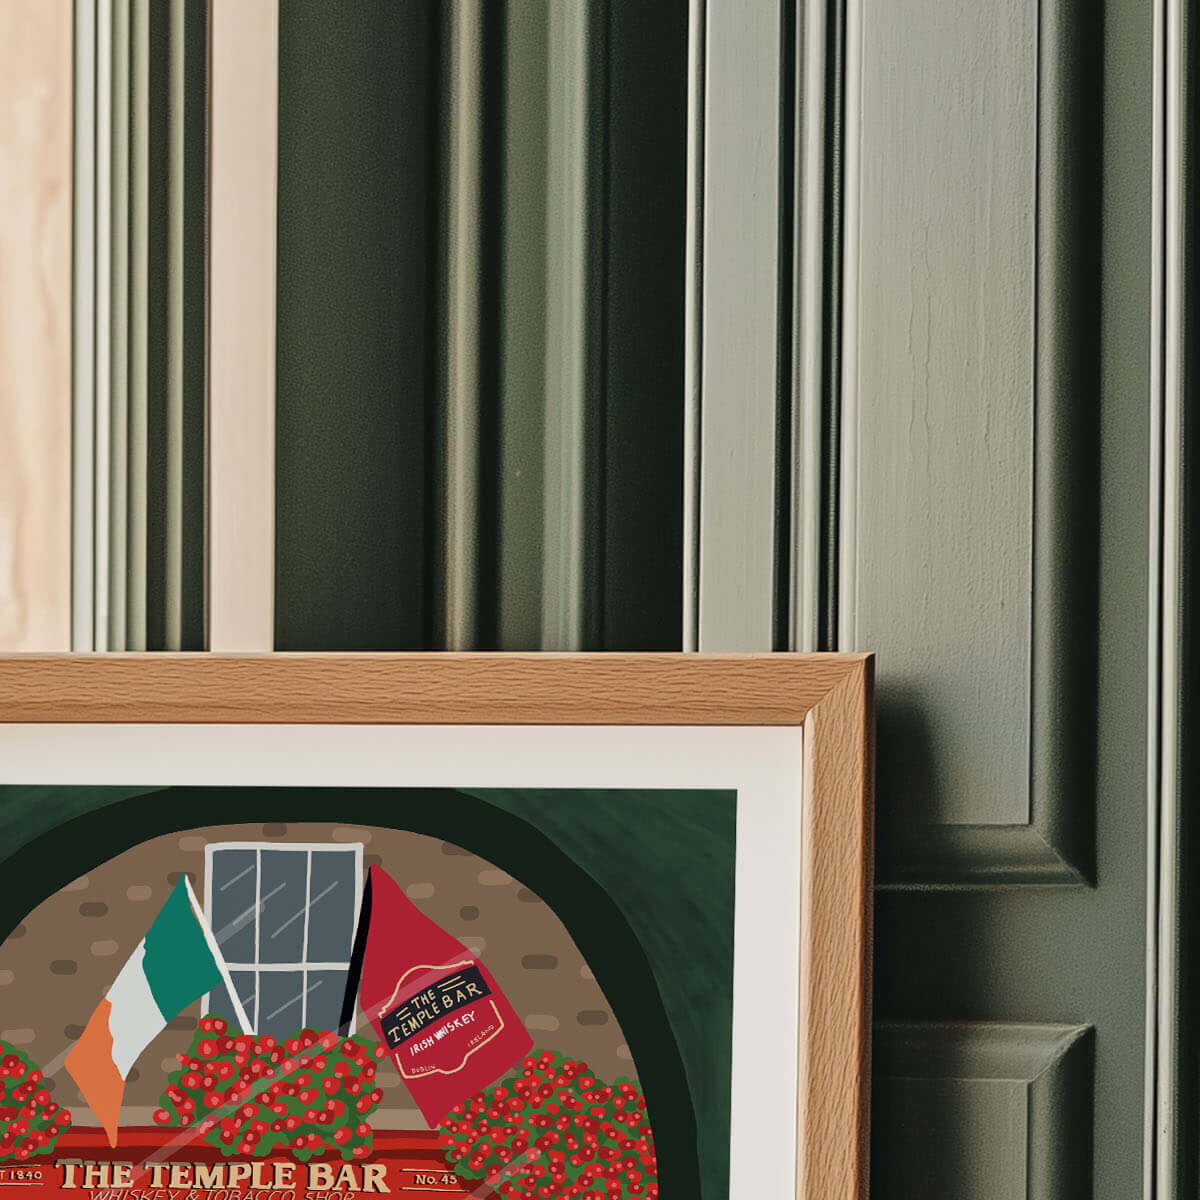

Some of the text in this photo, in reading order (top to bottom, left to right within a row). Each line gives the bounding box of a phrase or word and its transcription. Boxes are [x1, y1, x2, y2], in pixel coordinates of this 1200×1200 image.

[387, 982, 483, 1043] TEMPLE BAR
[410, 988, 437, 1010] THE
[409, 1010, 476, 1056] IRISH WHISKEY
[10, 1169, 43, 1180] 1840
[55, 1158, 391, 1194] THE TEMPLE BAR
[413, 1173, 458, 1186] No. 45
